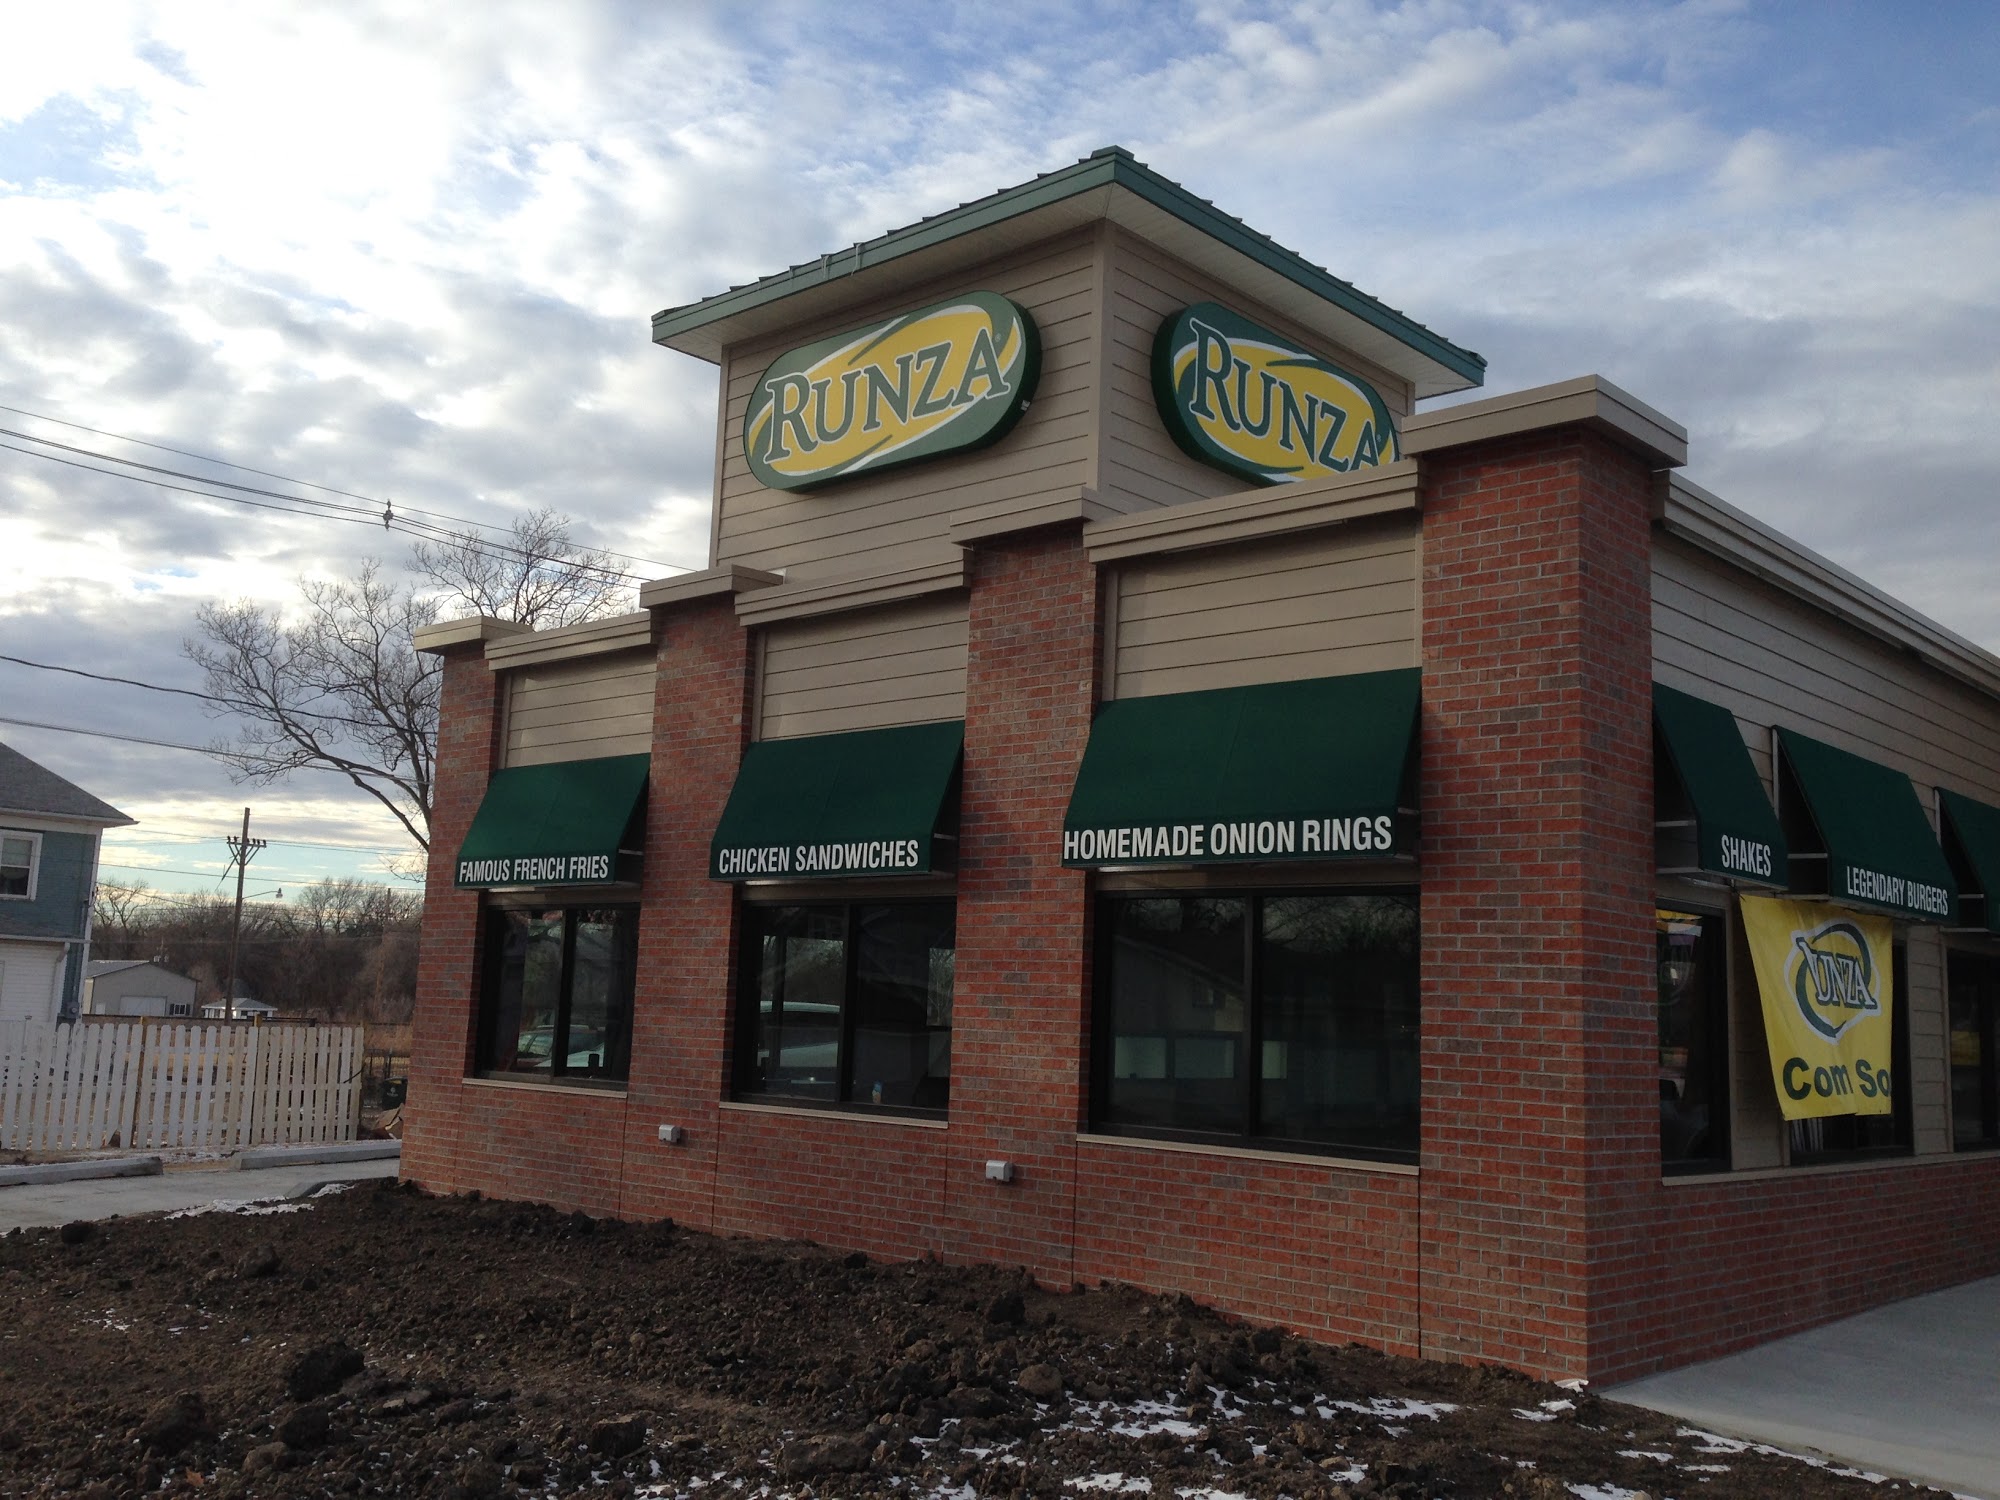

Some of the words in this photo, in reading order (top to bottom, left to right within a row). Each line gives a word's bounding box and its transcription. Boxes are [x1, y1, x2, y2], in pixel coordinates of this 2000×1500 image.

[763, 327, 1012, 465] RUNZA
[1188, 317, 1381, 474] RUNZA
[719, 846, 790, 874] CHICKEN
[795, 839, 919, 872] SANDWICHES
[1063, 824, 1204, 860] HOMEMADE
[1210, 820, 1295, 855] ONION
[1302, 815, 1392, 851] RINGS
[1721, 834, 1772, 877] SHAKES
[459, 858, 510, 883] FAMOUS
[513, 857, 566, 882] FRENCH
[569, 855, 609, 880] FRIES
[1846, 866, 1906, 906] LEGENDARY
[1907, 880, 1949, 916] BURGERS
